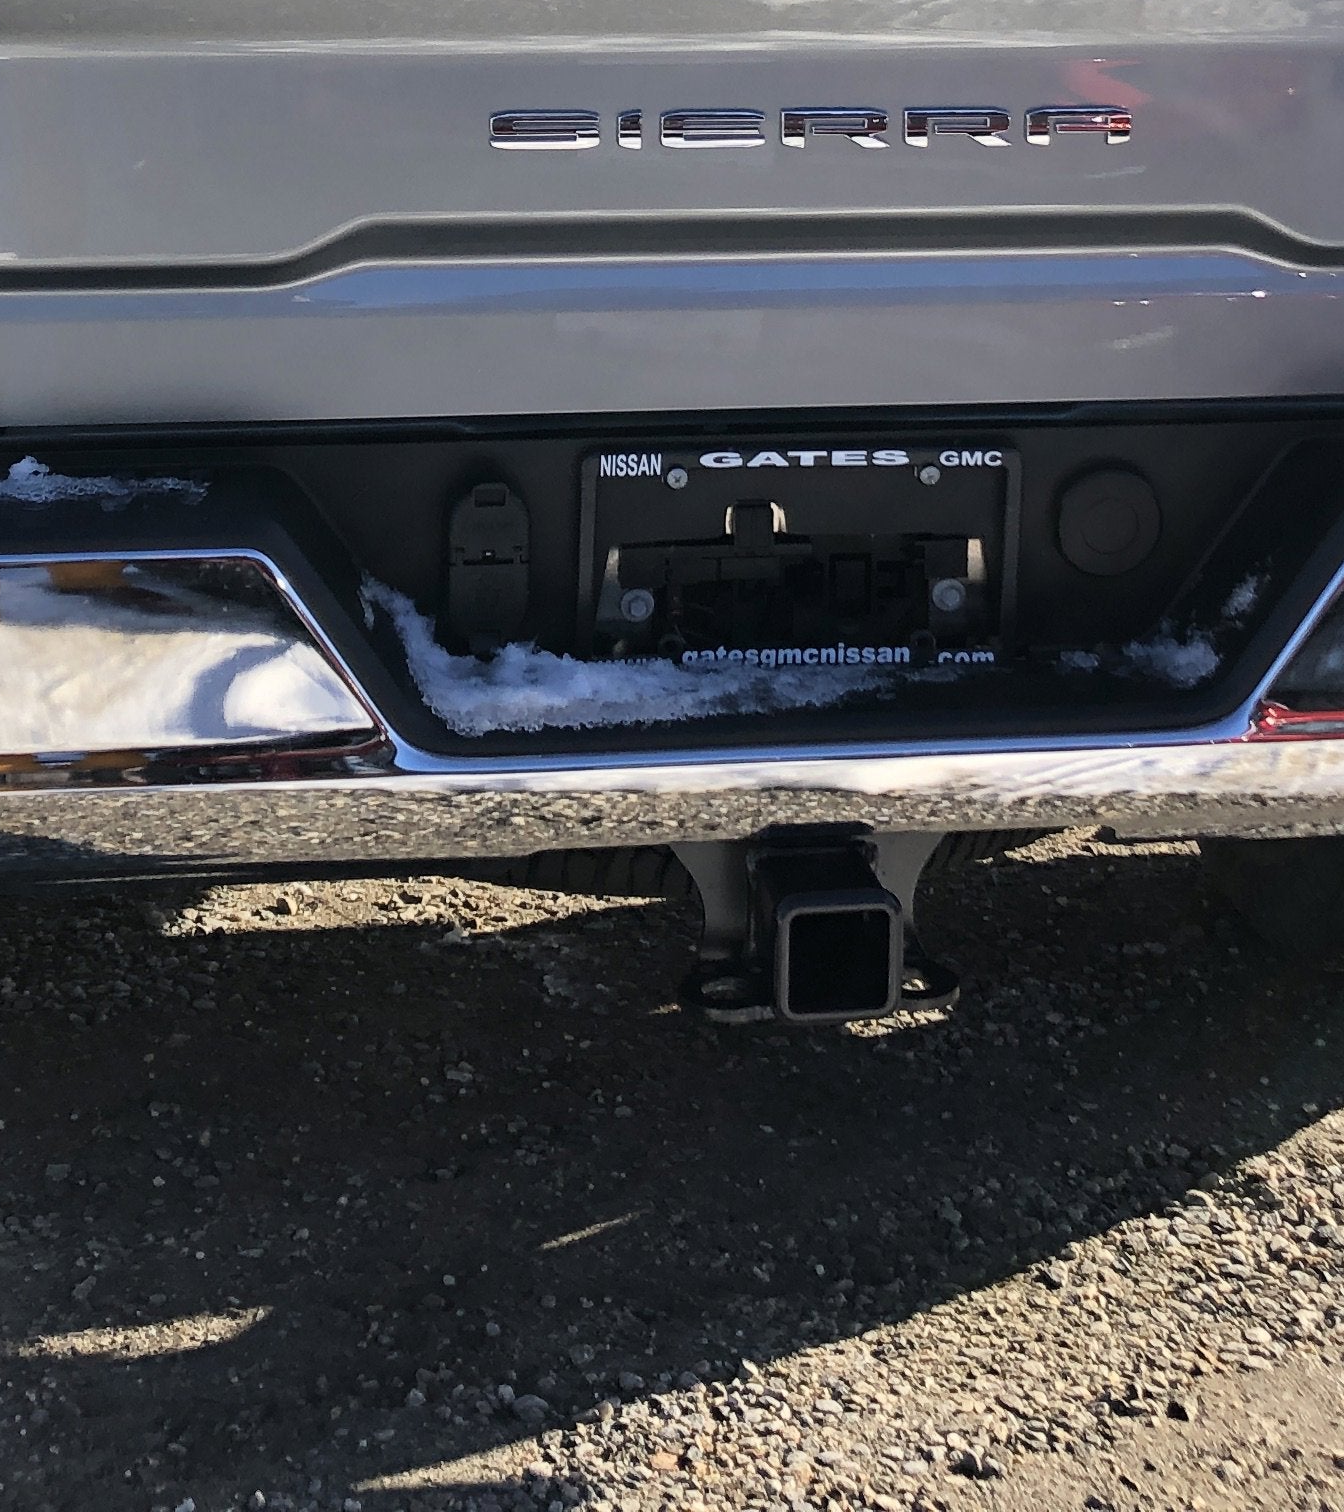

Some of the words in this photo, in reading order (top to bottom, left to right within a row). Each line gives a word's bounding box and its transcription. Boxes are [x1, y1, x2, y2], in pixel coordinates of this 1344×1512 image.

[489, 108, 1133, 150] SIERRA
[600, 453, 662, 478] NISSAN
[699, 450, 910, 469] GATES
[939, 450, 1003, 467] GMC
